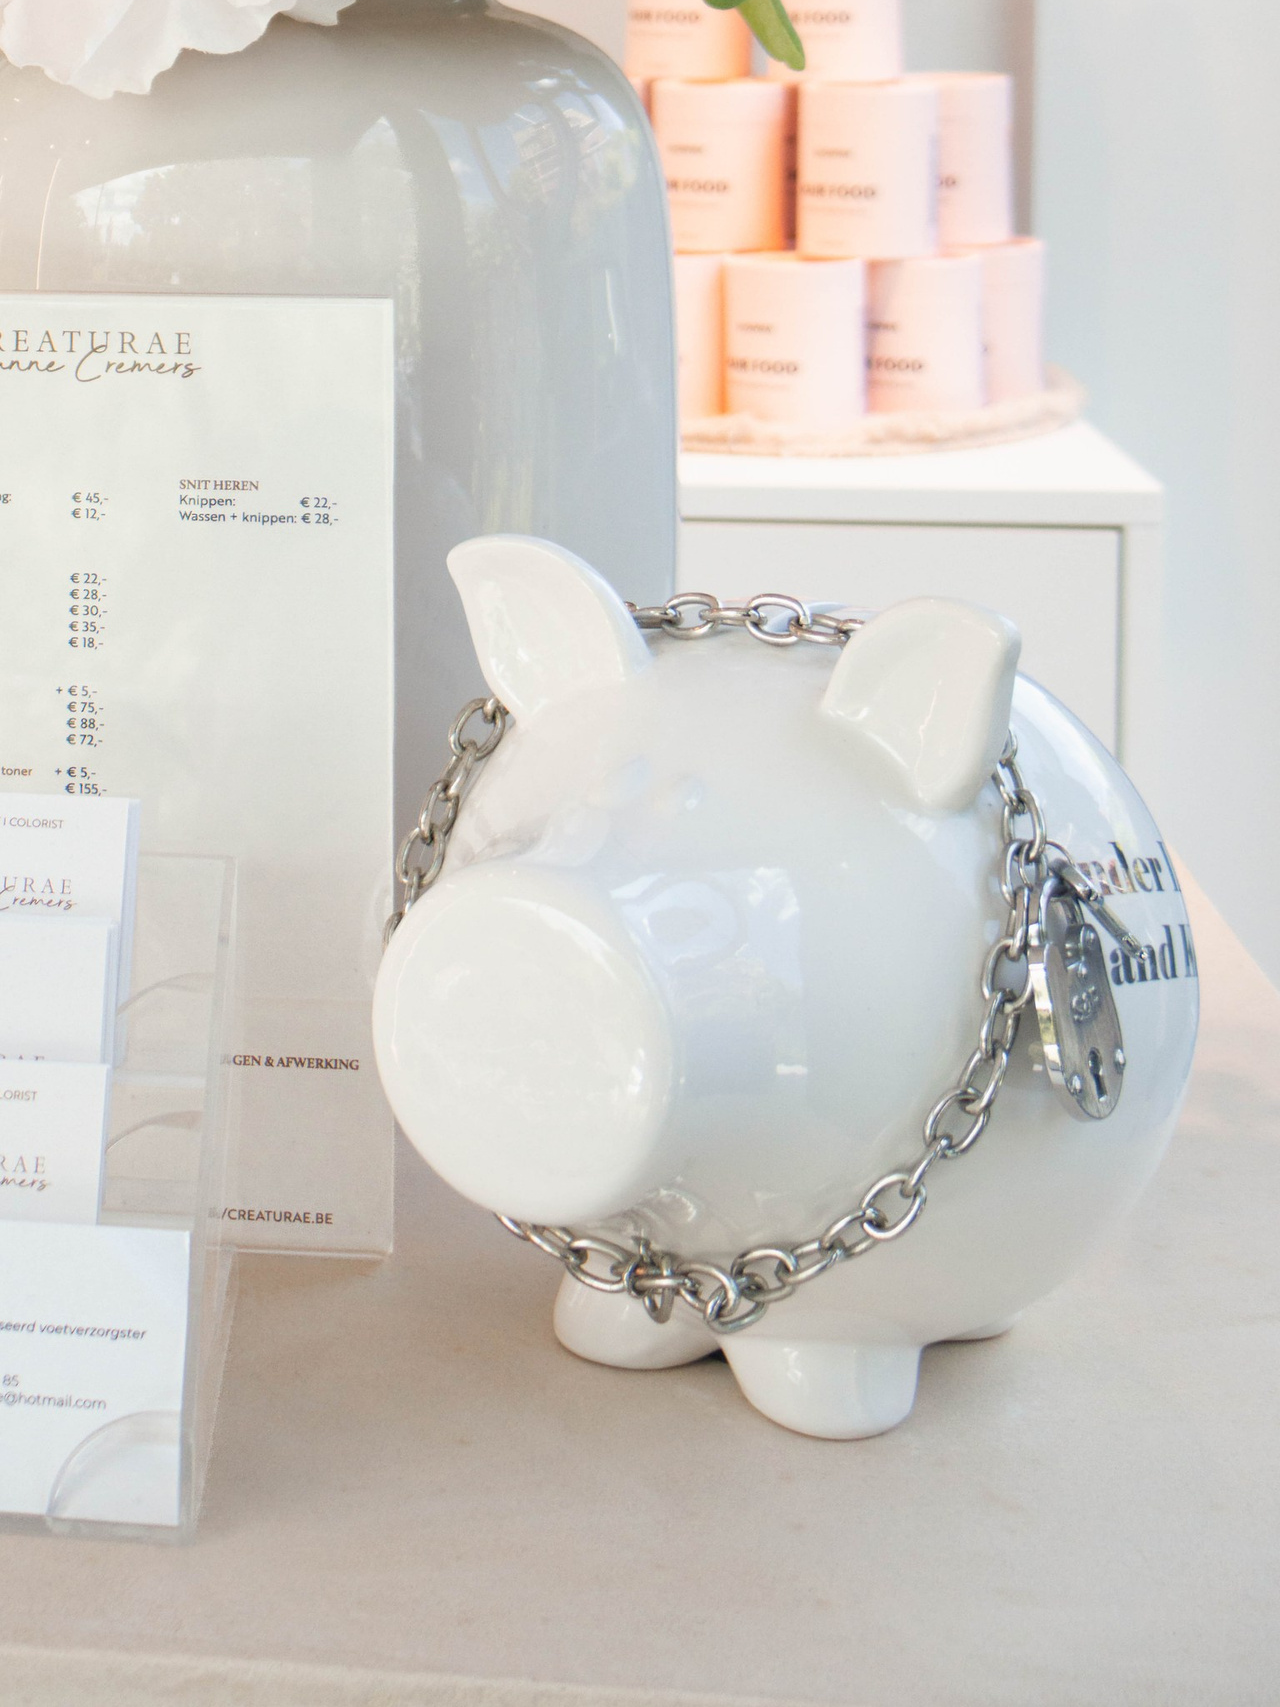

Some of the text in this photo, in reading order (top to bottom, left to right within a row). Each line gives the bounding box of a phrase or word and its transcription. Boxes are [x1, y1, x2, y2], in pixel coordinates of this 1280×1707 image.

[75, 344, 201, 382] Cremers
[179, 479, 259, 491] SNIT HEREN
[72, 492, 82, 503] €
[85, 493, 109, 505] 45,-
[179, 494, 338, 510] Knippen: € 22,-
[72, 508, 81, 519] €
[85, 508, 106, 521] 12,-
[179, 510, 226, 522] Wassen
[242, 512, 297, 526] knippen:
[301, 513, 311, 524] €
[315, 513, 339, 526] 28,-
[70, 573, 80, 584] €
[83, 573, 107, 586] 22,-
[70, 589, 80, 600] €
[83, 589, 107, 602] 28,-
[70, 605, 79, 616] €
[82, 605, 108, 618] 30,-
[69, 621, 79, 632] €
[82, 621, 105, 634] 35,-
[69, 637, 79, 648] €
[83, 637, 104, 650] 18,-
[68, 685, 77, 696] €
[81, 685, 98, 699] 5,-
[67, 702, 77, 713] €
[80, 702, 104, 715] 75,-
[67, 718, 76, 729] €
[80, 718, 105, 731] 88,-
[66, 734, 76, 745] €
[79, 734, 103, 747] 72,-
[1, 765, 32, 776] toner
[67, 767, 76, 778] €
[80, 767, 96, 780] 5,-
[65, 783, 75, 794] €
[79, 783, 107, 796] 155,-
[10, 817, 64, 829] COLORIST
[1110, 925, 1178, 985] and
[264, 1056, 274, 1067] &
[277, 1057, 360, 1071] AFWERKING
[39, 1322, 147, 1341] voetverzorgster
[2, 1374, 19, 1387] 85
